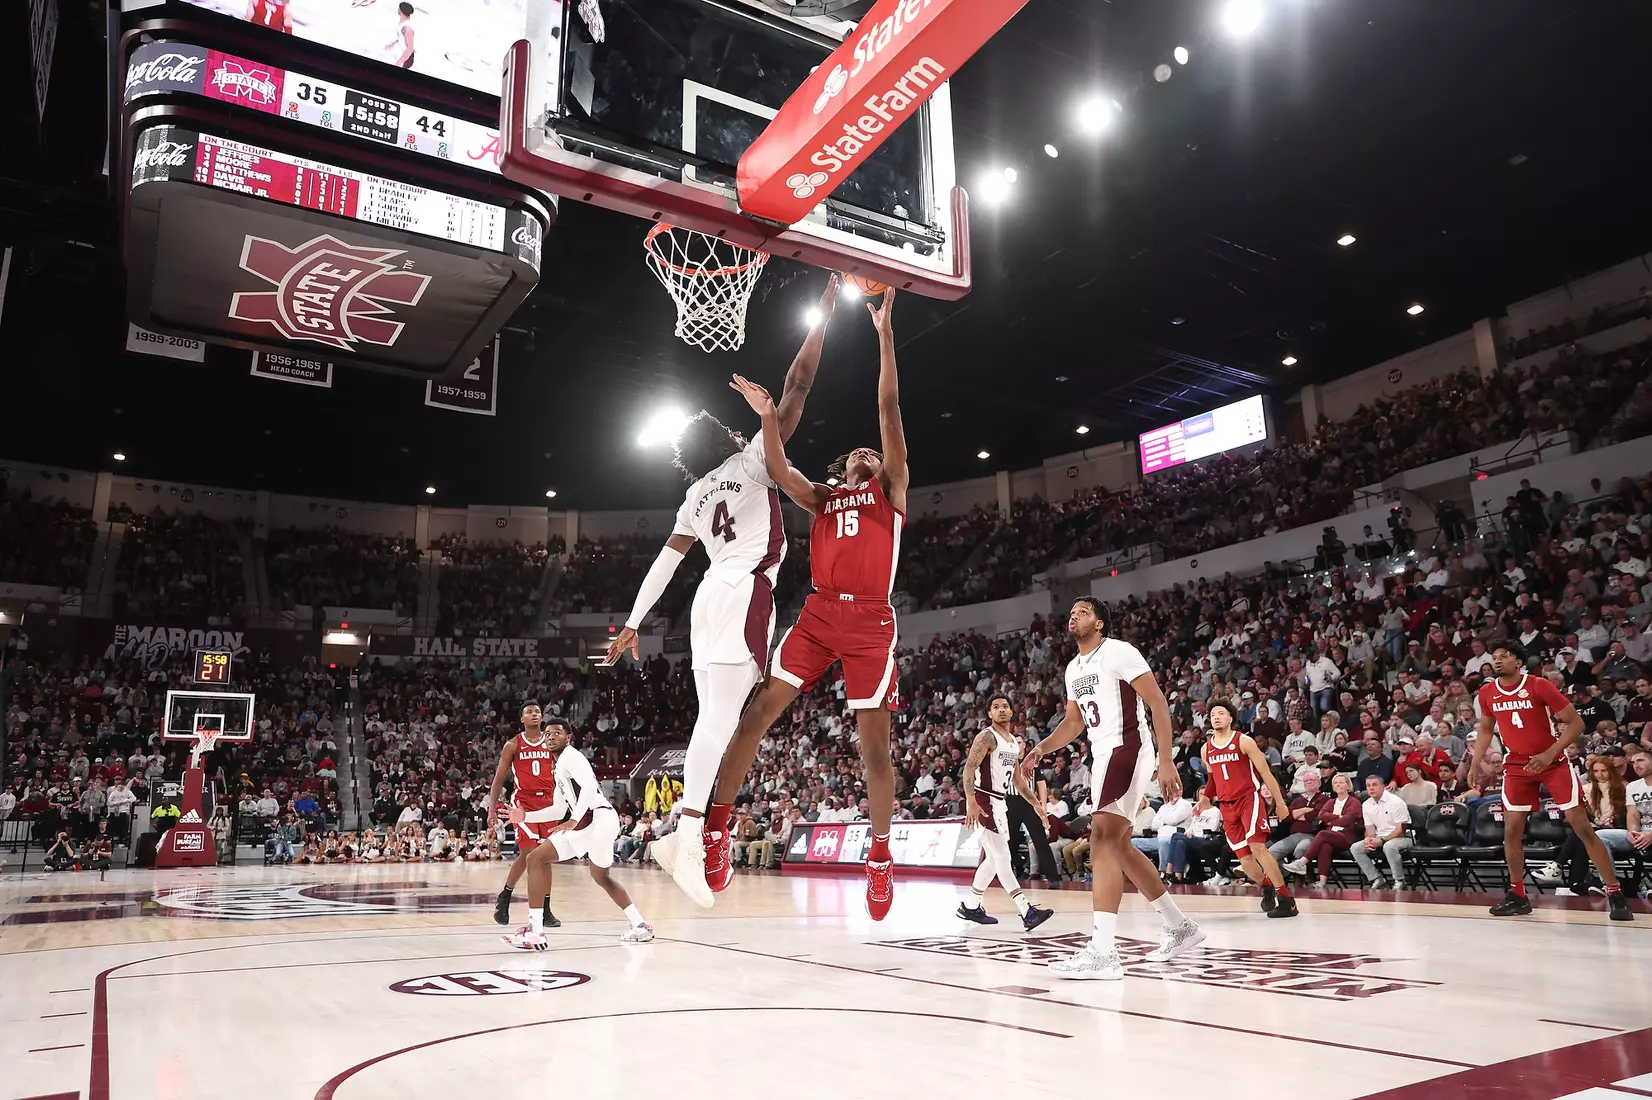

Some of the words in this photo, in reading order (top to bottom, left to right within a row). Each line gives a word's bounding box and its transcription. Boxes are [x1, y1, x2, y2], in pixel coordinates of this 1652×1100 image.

[225, 74, 264, 92] STATE
[296, 82, 327, 106] 35
[288, 101, 298, 113] 2
[361, 97, 385, 109] POSS
[285, 110, 299, 120] FLS
[344, 103, 398, 129] 15:58
[319, 119, 334, 129] TOL
[350, 123, 370, 134] 2ND
[371, 129, 392, 140] Half
[415, 115, 446, 138] 44
[204, 136, 218, 145] ON
[221, 139, 240, 150] THE
[242, 145, 274, 158] COURT
[404, 143, 418, 151] FLS
[406, 133, 416, 144] 3
[438, 141, 448, 153] 2
[215, 154, 252, 170] MOORE
[436, 150, 450, 160] TOL
[202, 160, 210, 169] 4
[214, 162, 272, 183] MATTHEWS
[216, 147, 260, 164] JEFFRIES
[318, 172, 329, 181] 11
[195, 173, 208, 183] 13
[213, 170, 245, 185] DAVIS
[367, 176, 379, 184] ON
[381, 179, 398, 188] THE
[400, 184, 428, 196] COURT
[292, 261, 363, 332] STATE
[134, 331, 200, 350] 1999-2003
[264, 353, 321, 371] 1956-1965
[270, 364, 290, 374] HEAD
[290, 368, 315, 378] COACH
[437, 385, 487, 401] 1957-1959
[694, 480, 743, 518] MATTEWS
[823, 492, 876, 515] ALABAMA
[711, 499, 737, 543] 4
[835, 509, 860, 540] 15
[114, 625, 127, 646] THE
[128, 625, 244, 652] MAROON
[413, 636, 466, 656] HAIL
[472, 637, 538, 657] STATE
[203, 654, 228, 665] 15:58
[200, 664, 224, 680] 21
[1492, 699, 1534, 712] ALABAMA
[1511, 711, 1524, 729] 4
[518, 750, 550, 761] ALABAMA
[1208, 752, 1240, 765] ALABAMA
[531, 760, 541, 777] 0
[1221, 763, 1230, 780] 1
[1002, 770, 1013, 790] 3
